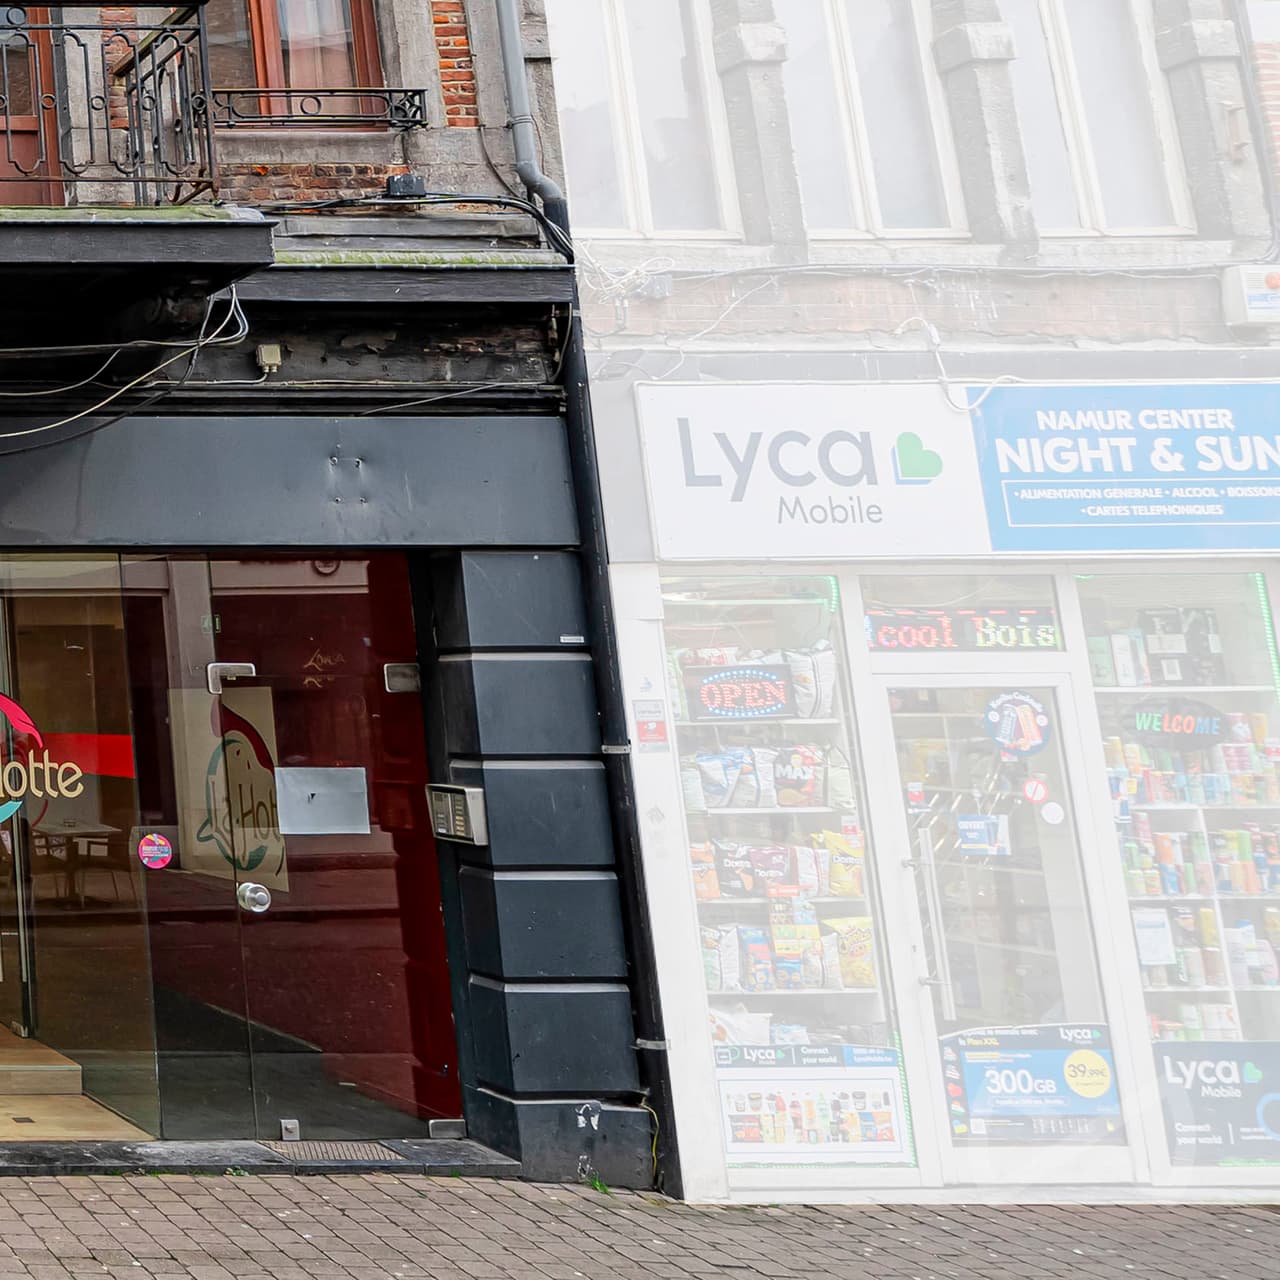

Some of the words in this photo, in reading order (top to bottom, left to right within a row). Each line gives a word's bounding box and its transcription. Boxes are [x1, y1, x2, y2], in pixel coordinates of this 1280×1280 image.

[1036, 410, 1132, 431] NAMUR
[1138, 408, 1235, 431] CENTER
[677, 417, 878, 503] Lyca
[995, 437, 1144, 472] NIGHT
[1151, 437, 1185, 472] &
[1104, 488, 1162, 499] GENERALE
[1172, 487, 1219, 498] ALCOOL
[777, 495, 883, 525] Mobile
[1087, 505, 1129, 517] CARTES
[700, 681, 786, 708] OPEN
[1135, 710, 1222, 736] WELCOME
[1059, 1028, 1093, 1042] Lyca
[743, 1047, 777, 1063] Lyca
[1162, 1055, 1241, 1089] Lyca
